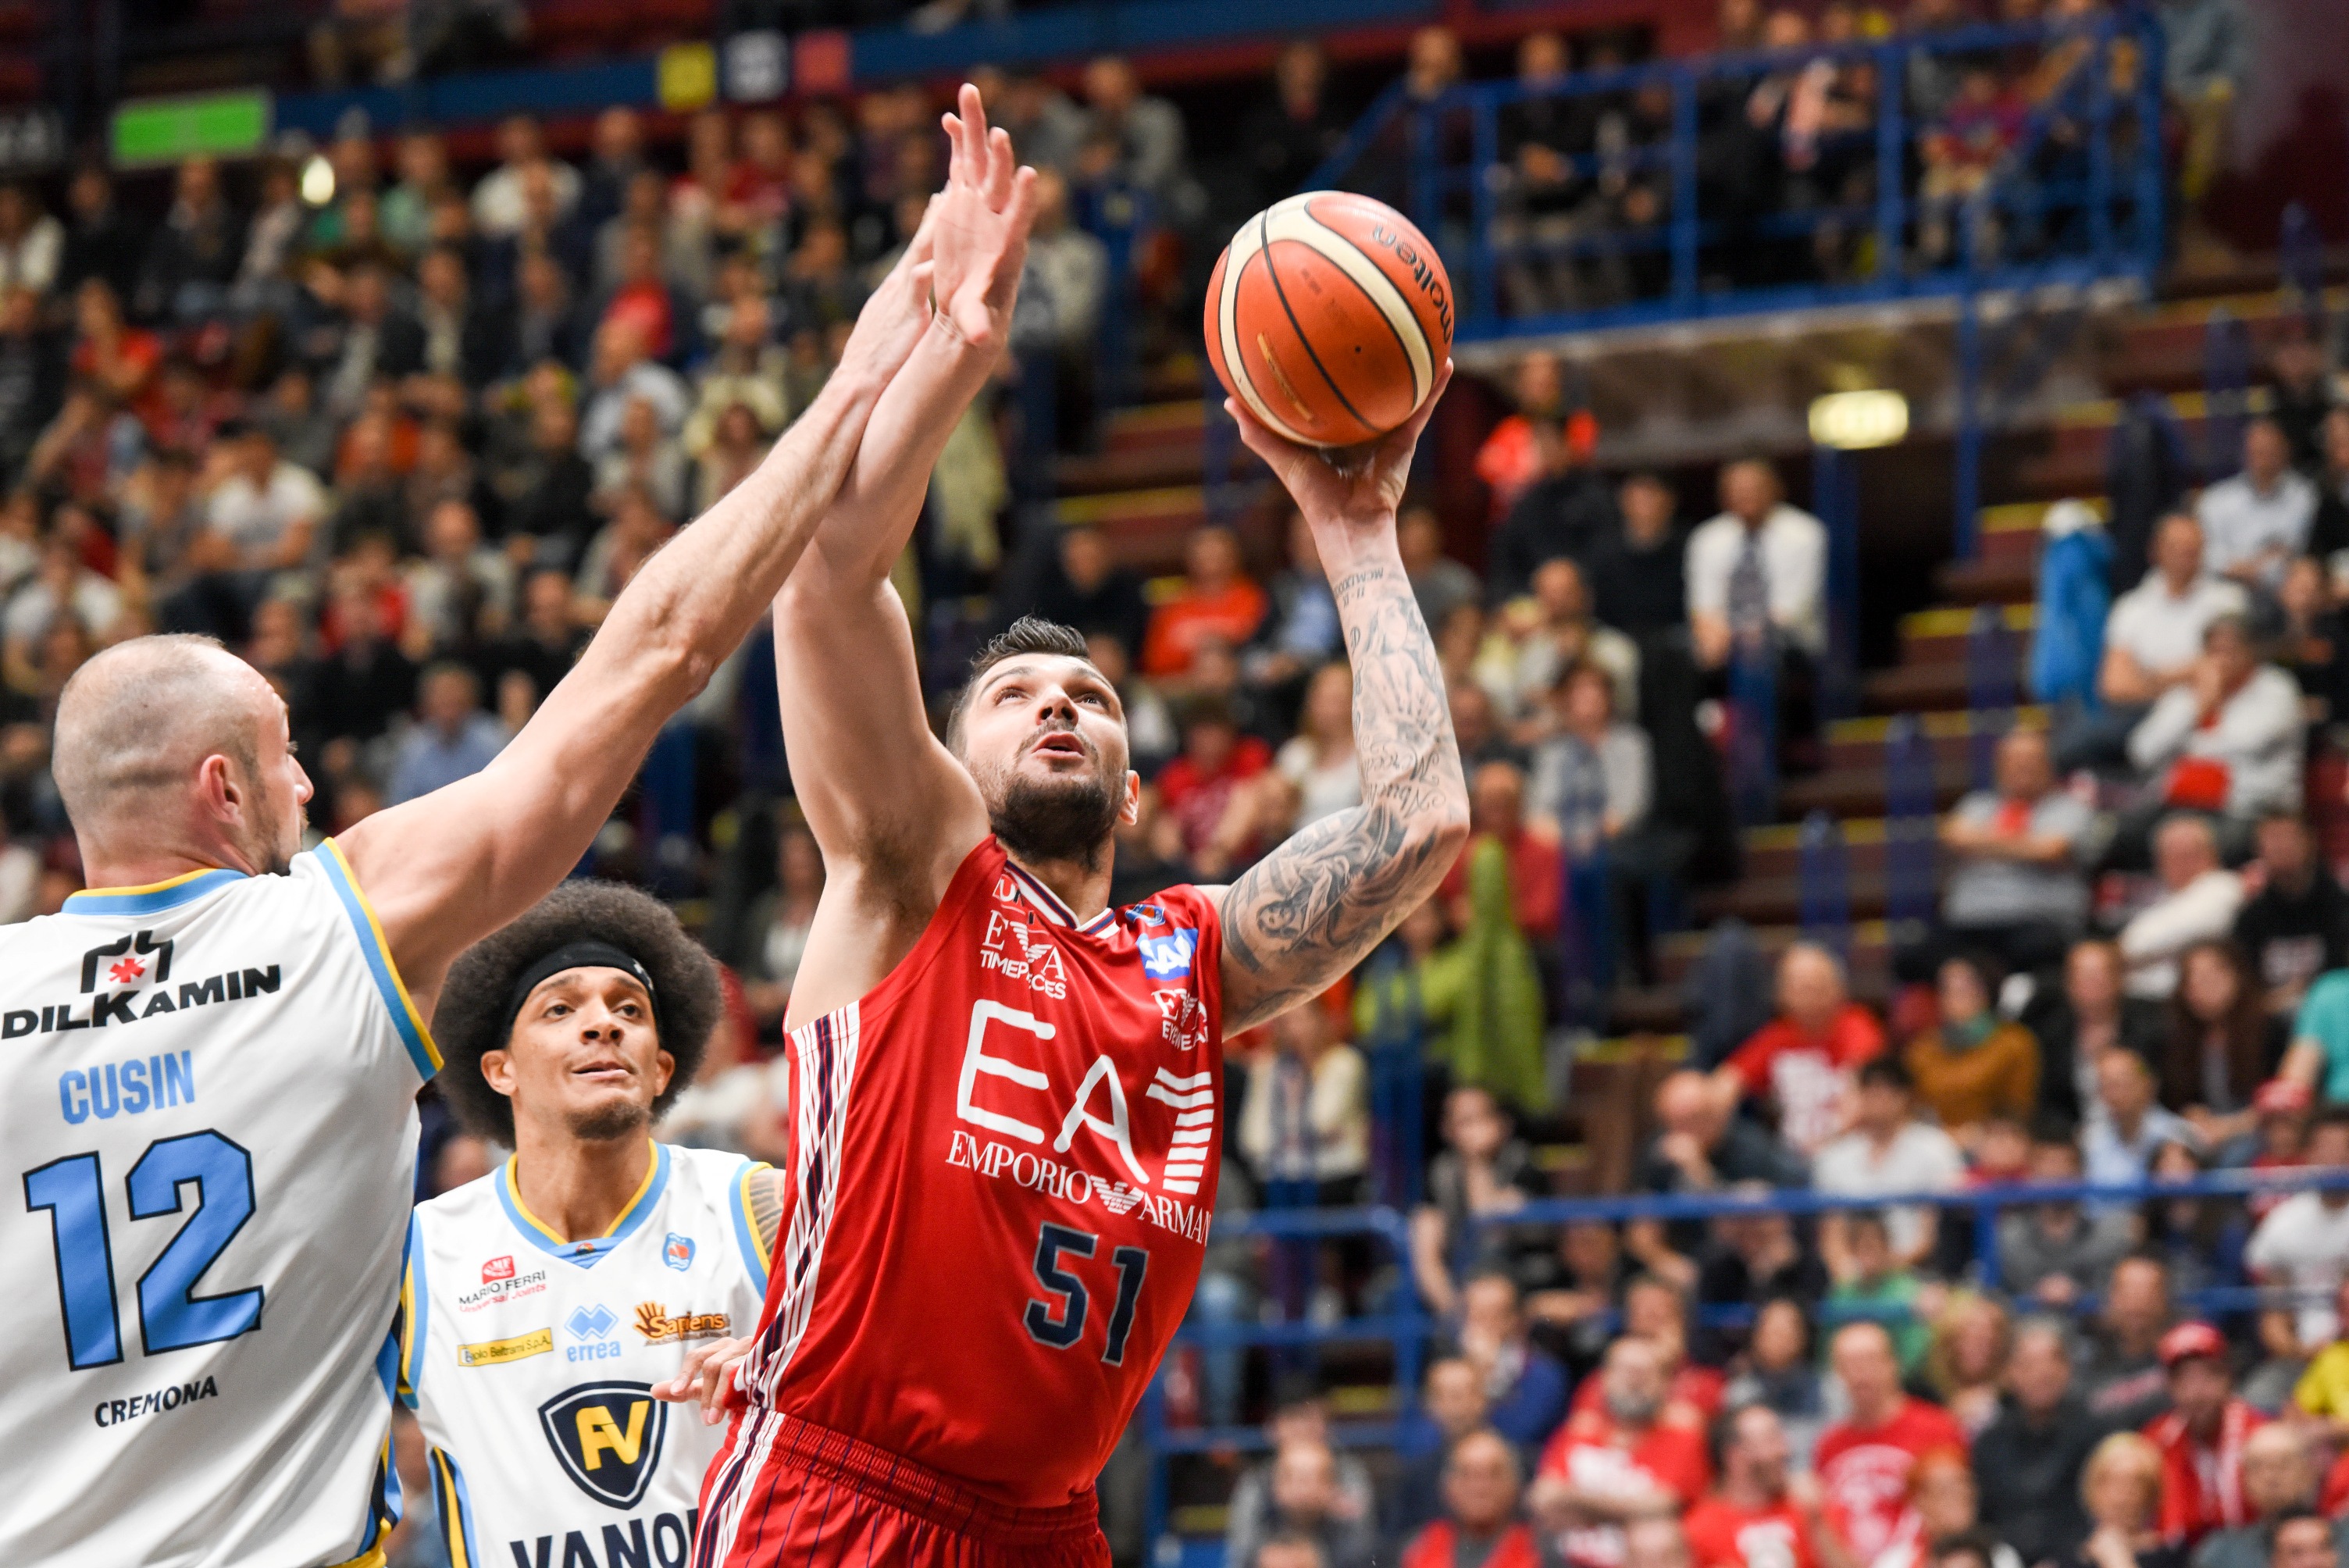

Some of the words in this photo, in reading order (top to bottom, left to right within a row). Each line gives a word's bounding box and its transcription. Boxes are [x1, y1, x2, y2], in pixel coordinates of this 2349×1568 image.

[1373, 225, 1453, 345] molten
[1, 964, 281, 1040] DILKAMIN
[980, 950, 1067, 1000] TIMEPCES
[59, 1049, 195, 1125] CUSIN
[945, 1130, 1093, 1205] EMPORIO
[23, 1128, 266, 1372] 12
[459, 1282, 501, 1305] MARIO
[505, 1270, 546, 1291] FERRI
[512, 1283, 547, 1299] Joints
[1022, 1220, 1150, 1368] 51
[567, 1341, 621, 1362] errea
[649, 1310, 726, 1341] Sapiens
[94, 1376, 218, 1428] CREMONA
